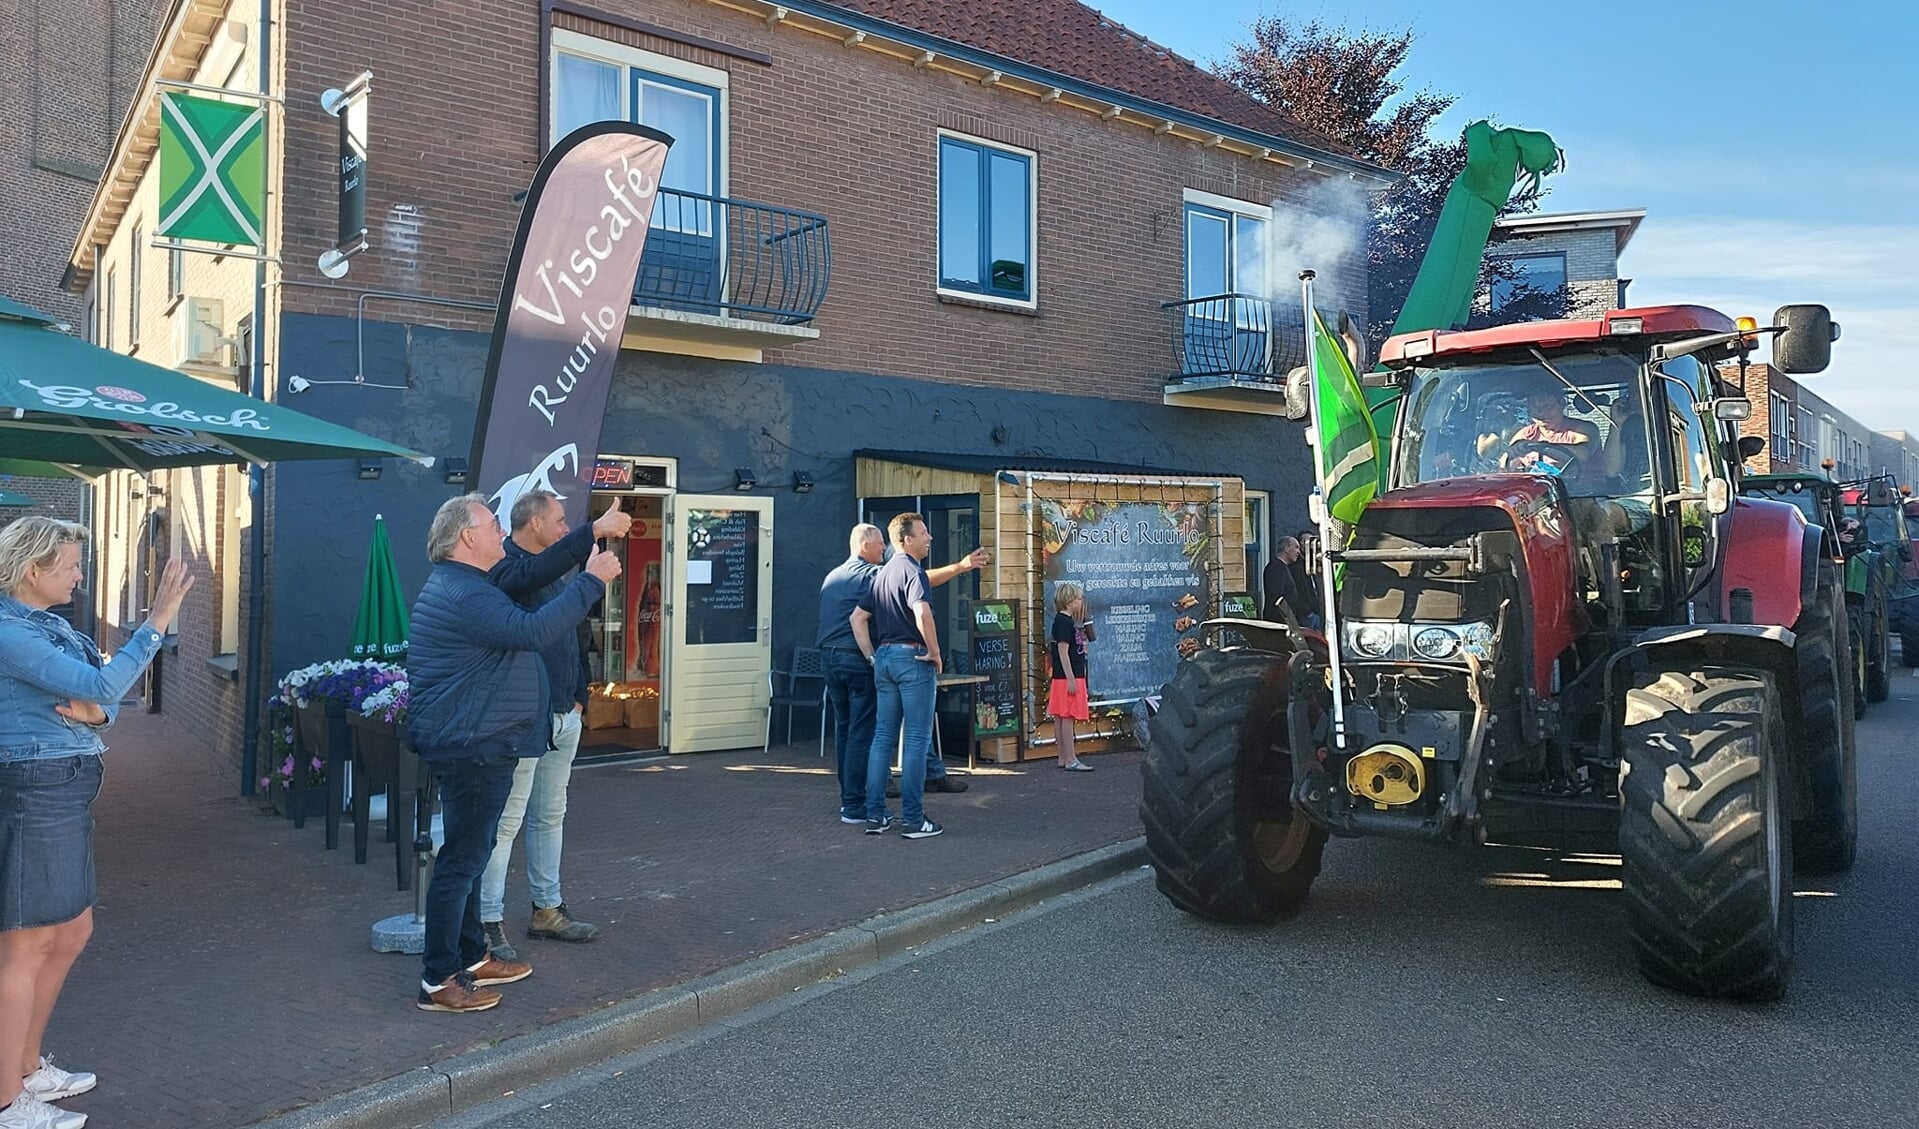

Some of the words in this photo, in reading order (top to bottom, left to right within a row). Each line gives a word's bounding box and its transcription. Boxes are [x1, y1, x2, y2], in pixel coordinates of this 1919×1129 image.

[515, 154, 655, 326] Viscafé
[528, 304, 617, 426] Ruurlo
[19, 380, 271, 431] Grolsch
[1053, 519, 1130, 549] Viscafé
[1136, 521, 1200, 545] Ruurlo
[1065, 559, 1086, 573] Uw
[1088, 559, 1142, 573] vertrouwde
[1143, 557, 1169, 572] adres
[1169, 559, 1190, 571] voor
[1142, 573, 1185, 590] gebakken
[1185, 574, 1200, 587] vis
[979, 638, 1009, 653] VERSE
